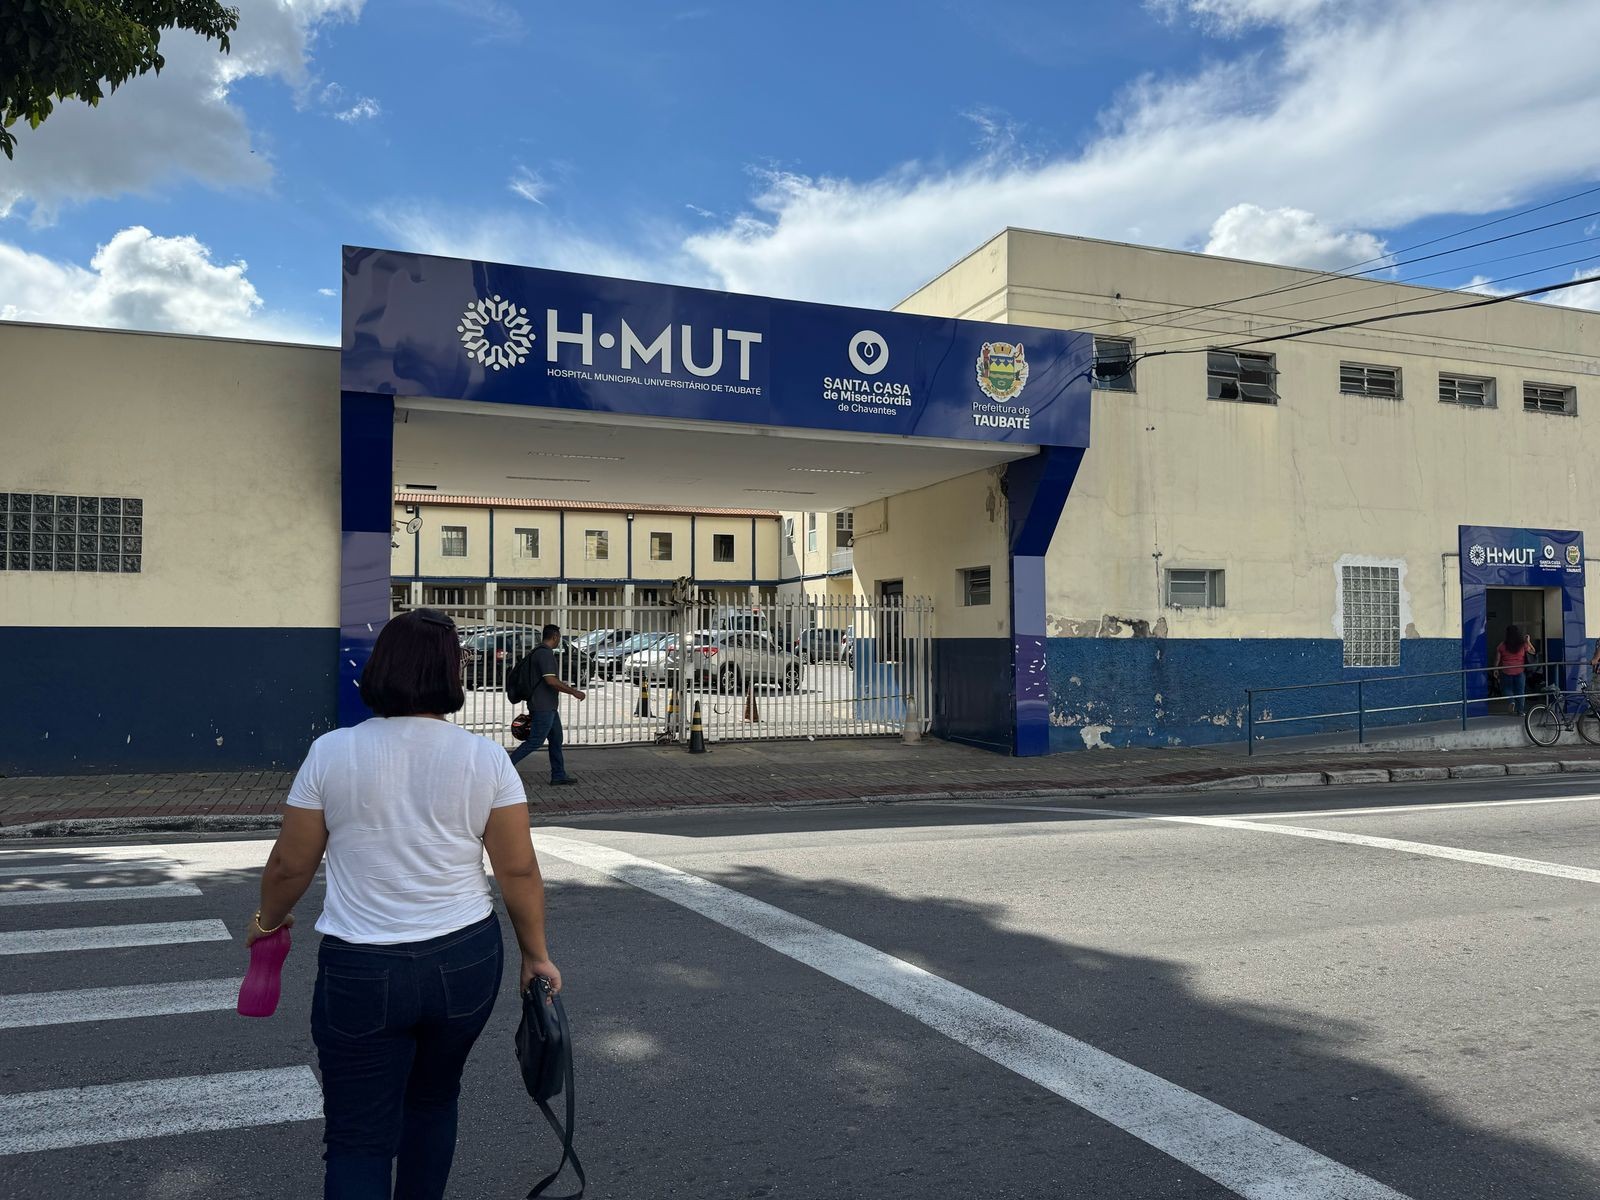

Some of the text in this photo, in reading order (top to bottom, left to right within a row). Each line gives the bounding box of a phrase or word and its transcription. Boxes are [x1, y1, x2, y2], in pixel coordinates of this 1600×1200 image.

[547, 368, 762, 396] HOSPITAL MUNICIPAL UNIVERSITÁRIO DE TAUBATÉ
[823, 377, 911, 396] SANTA CASA
[823, 389, 912, 406] de Misericórdia
[838, 403, 897, 416] de Chavantes
[972, 402, 1031, 415] Prefeitura de
[973, 414, 1030, 429] TAUBATÉ
